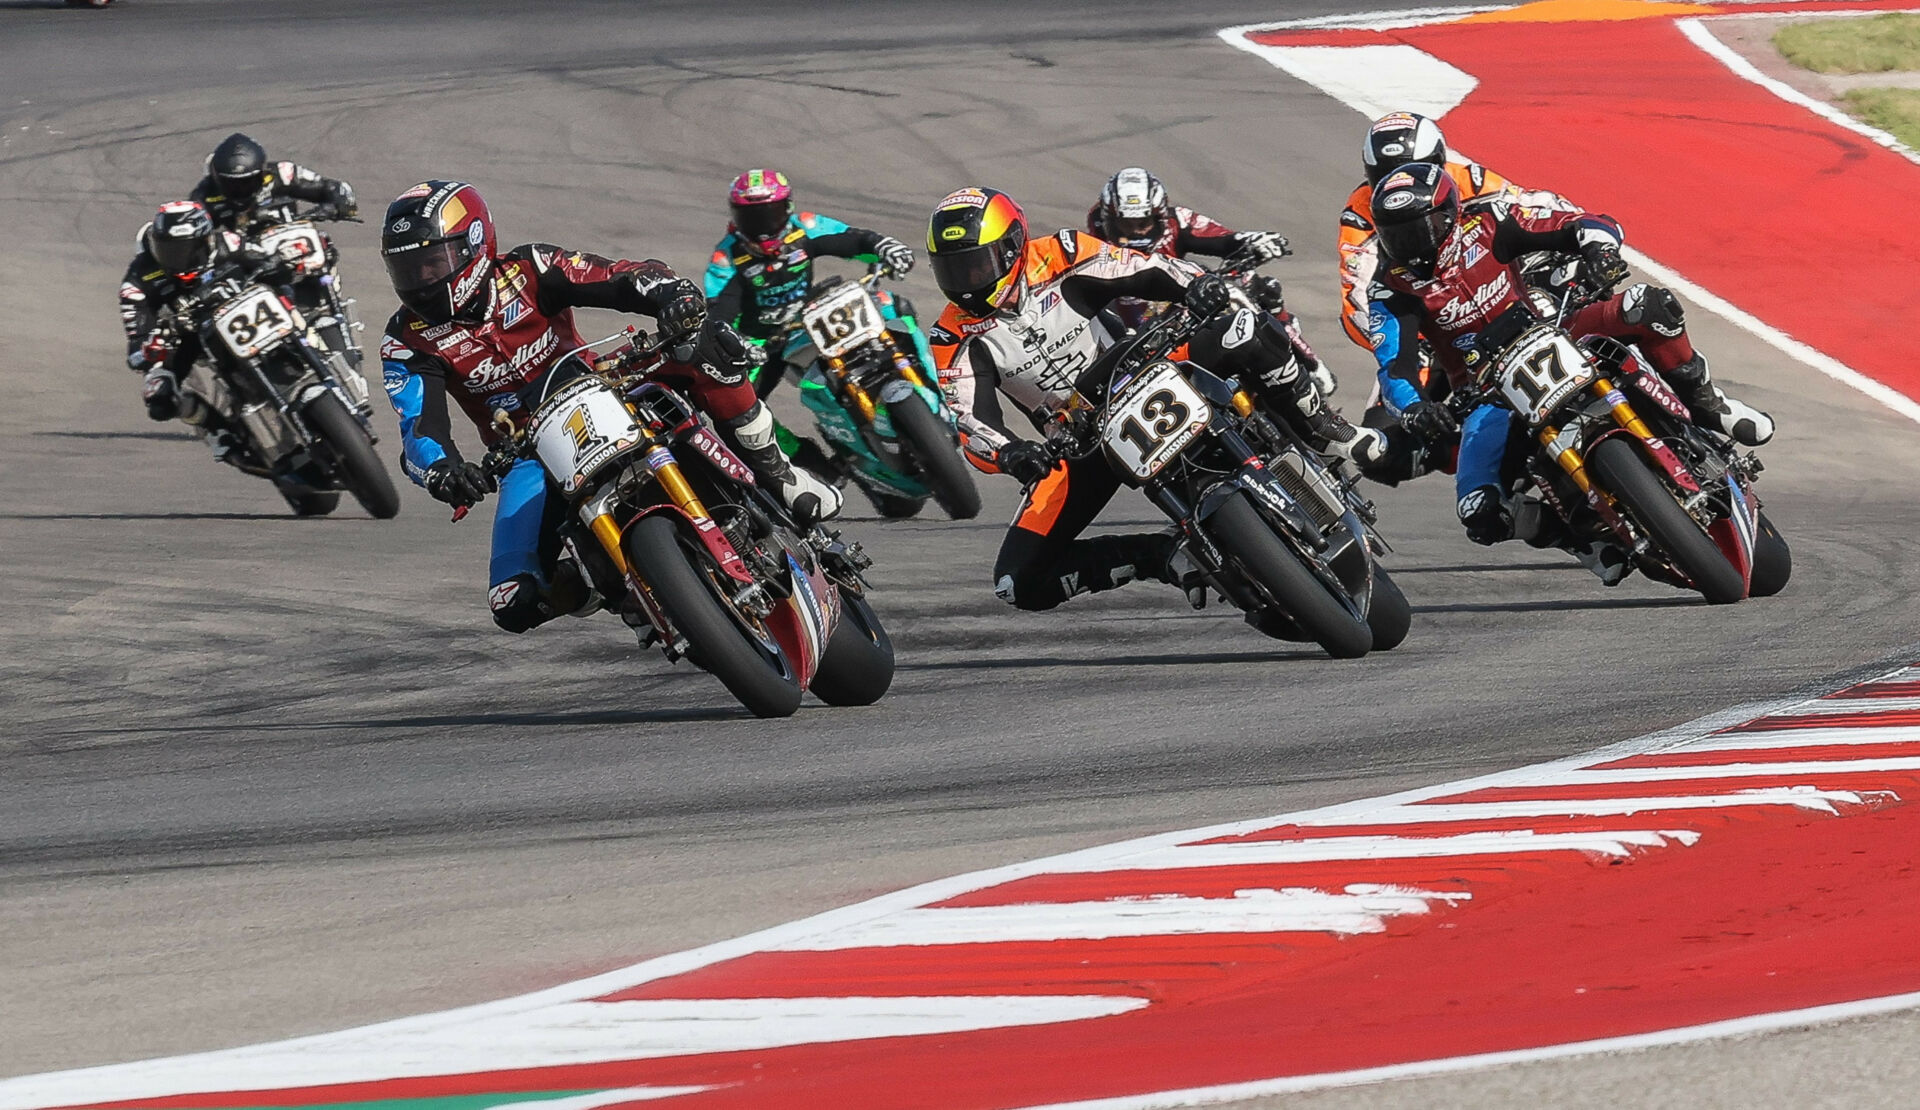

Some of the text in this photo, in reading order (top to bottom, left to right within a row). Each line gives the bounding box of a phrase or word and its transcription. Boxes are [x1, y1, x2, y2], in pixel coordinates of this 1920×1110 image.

[228, 300, 285, 346] 34
[811, 296, 872, 348] 137
[1435, 270, 1508, 325] Indian
[463, 326, 554, 388] Indian
[468, 335, 561, 395] MOTORCYCLE RACING
[1512, 341, 1569, 412] 17
[537, 402, 556, 422] Super
[1545, 382, 1577, 410] mission
[561, 403, 610, 469] 1
[1119, 387, 1191, 465] 13
[1159, 430, 1193, 463] mission
[581, 442, 618, 477] mission
